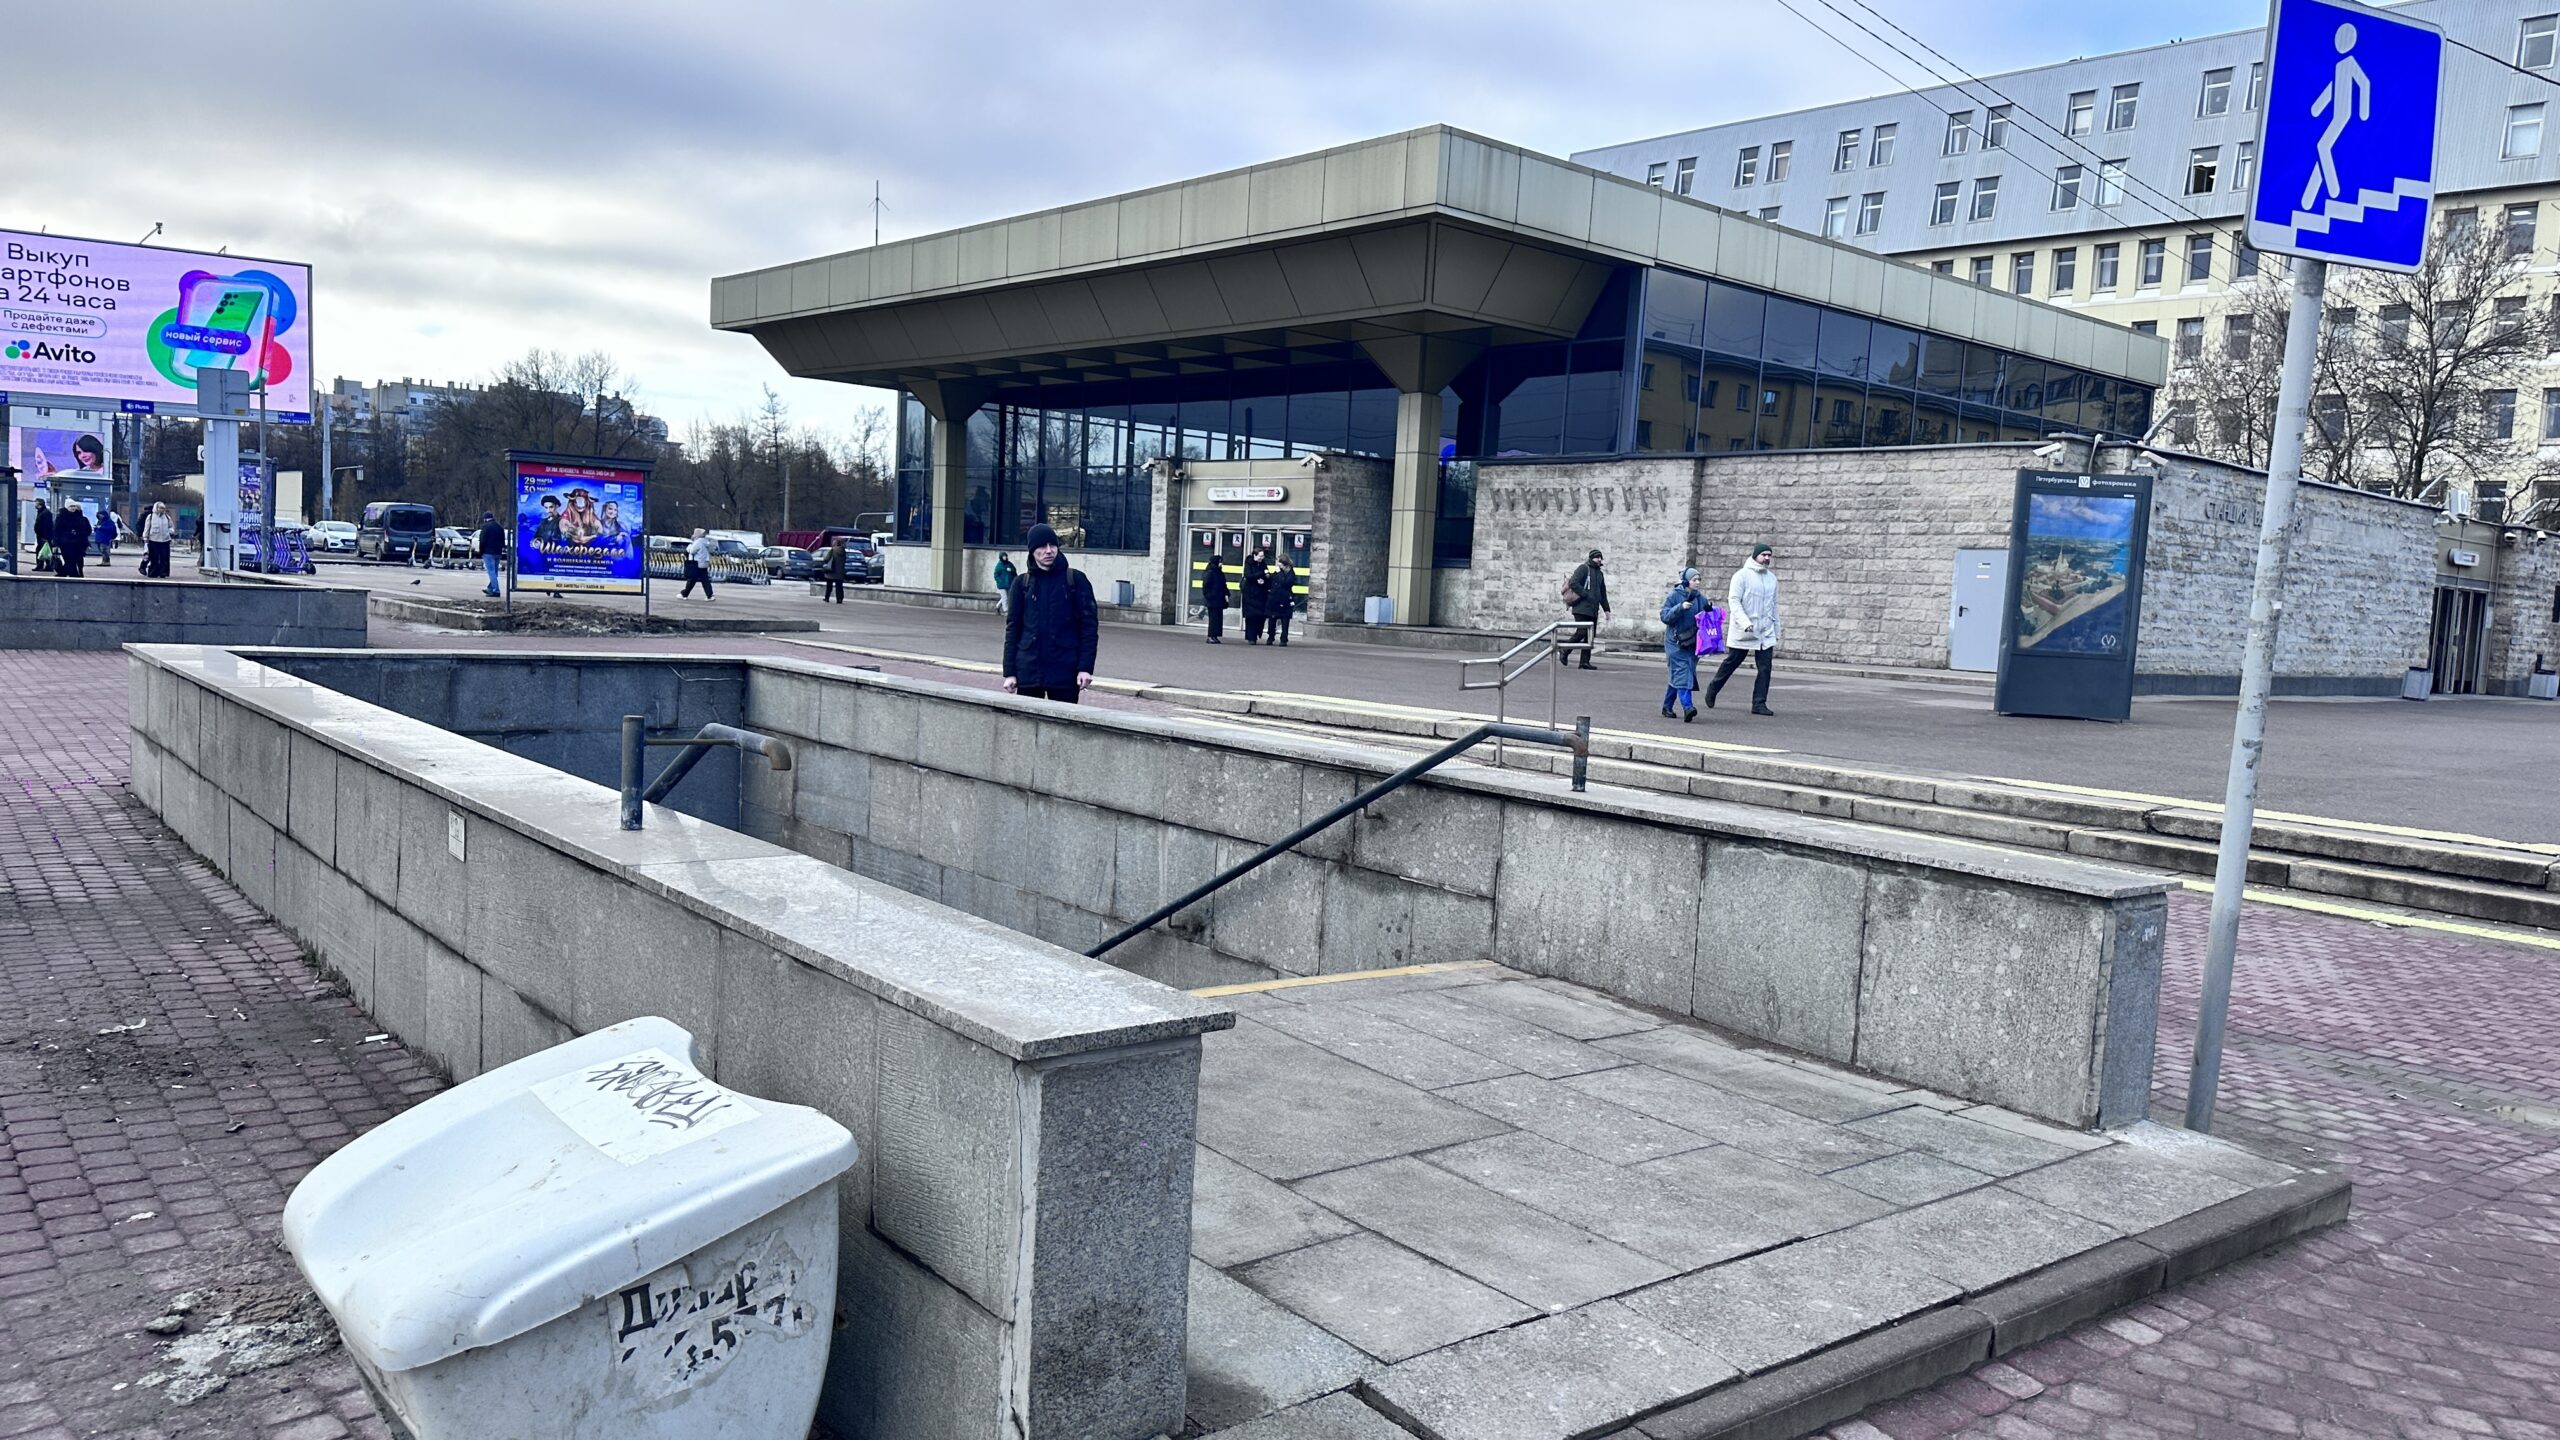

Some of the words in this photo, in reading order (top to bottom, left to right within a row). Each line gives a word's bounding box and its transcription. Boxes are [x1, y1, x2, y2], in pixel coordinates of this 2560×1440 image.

[8, 242, 89, 270] Выкуп
[1, 267, 131, 292] артфонов
[0, 287, 10, 300] а
[18, 285, 50, 304] 24
[57, 293, 116, 310] часа
[3, 310, 63, 324] Продайте
[65, 316, 96, 326] даже
[21, 322, 88, 334] дефектами
[165, 331, 200, 342] новый
[202, 336, 243, 348] сервис
[33, 341, 96, 363] Avito
[524, 476, 536, 485] 29
[524, 485, 536, 494] 30
[2205, 502, 2248, 525] СТАНЦИЯ
